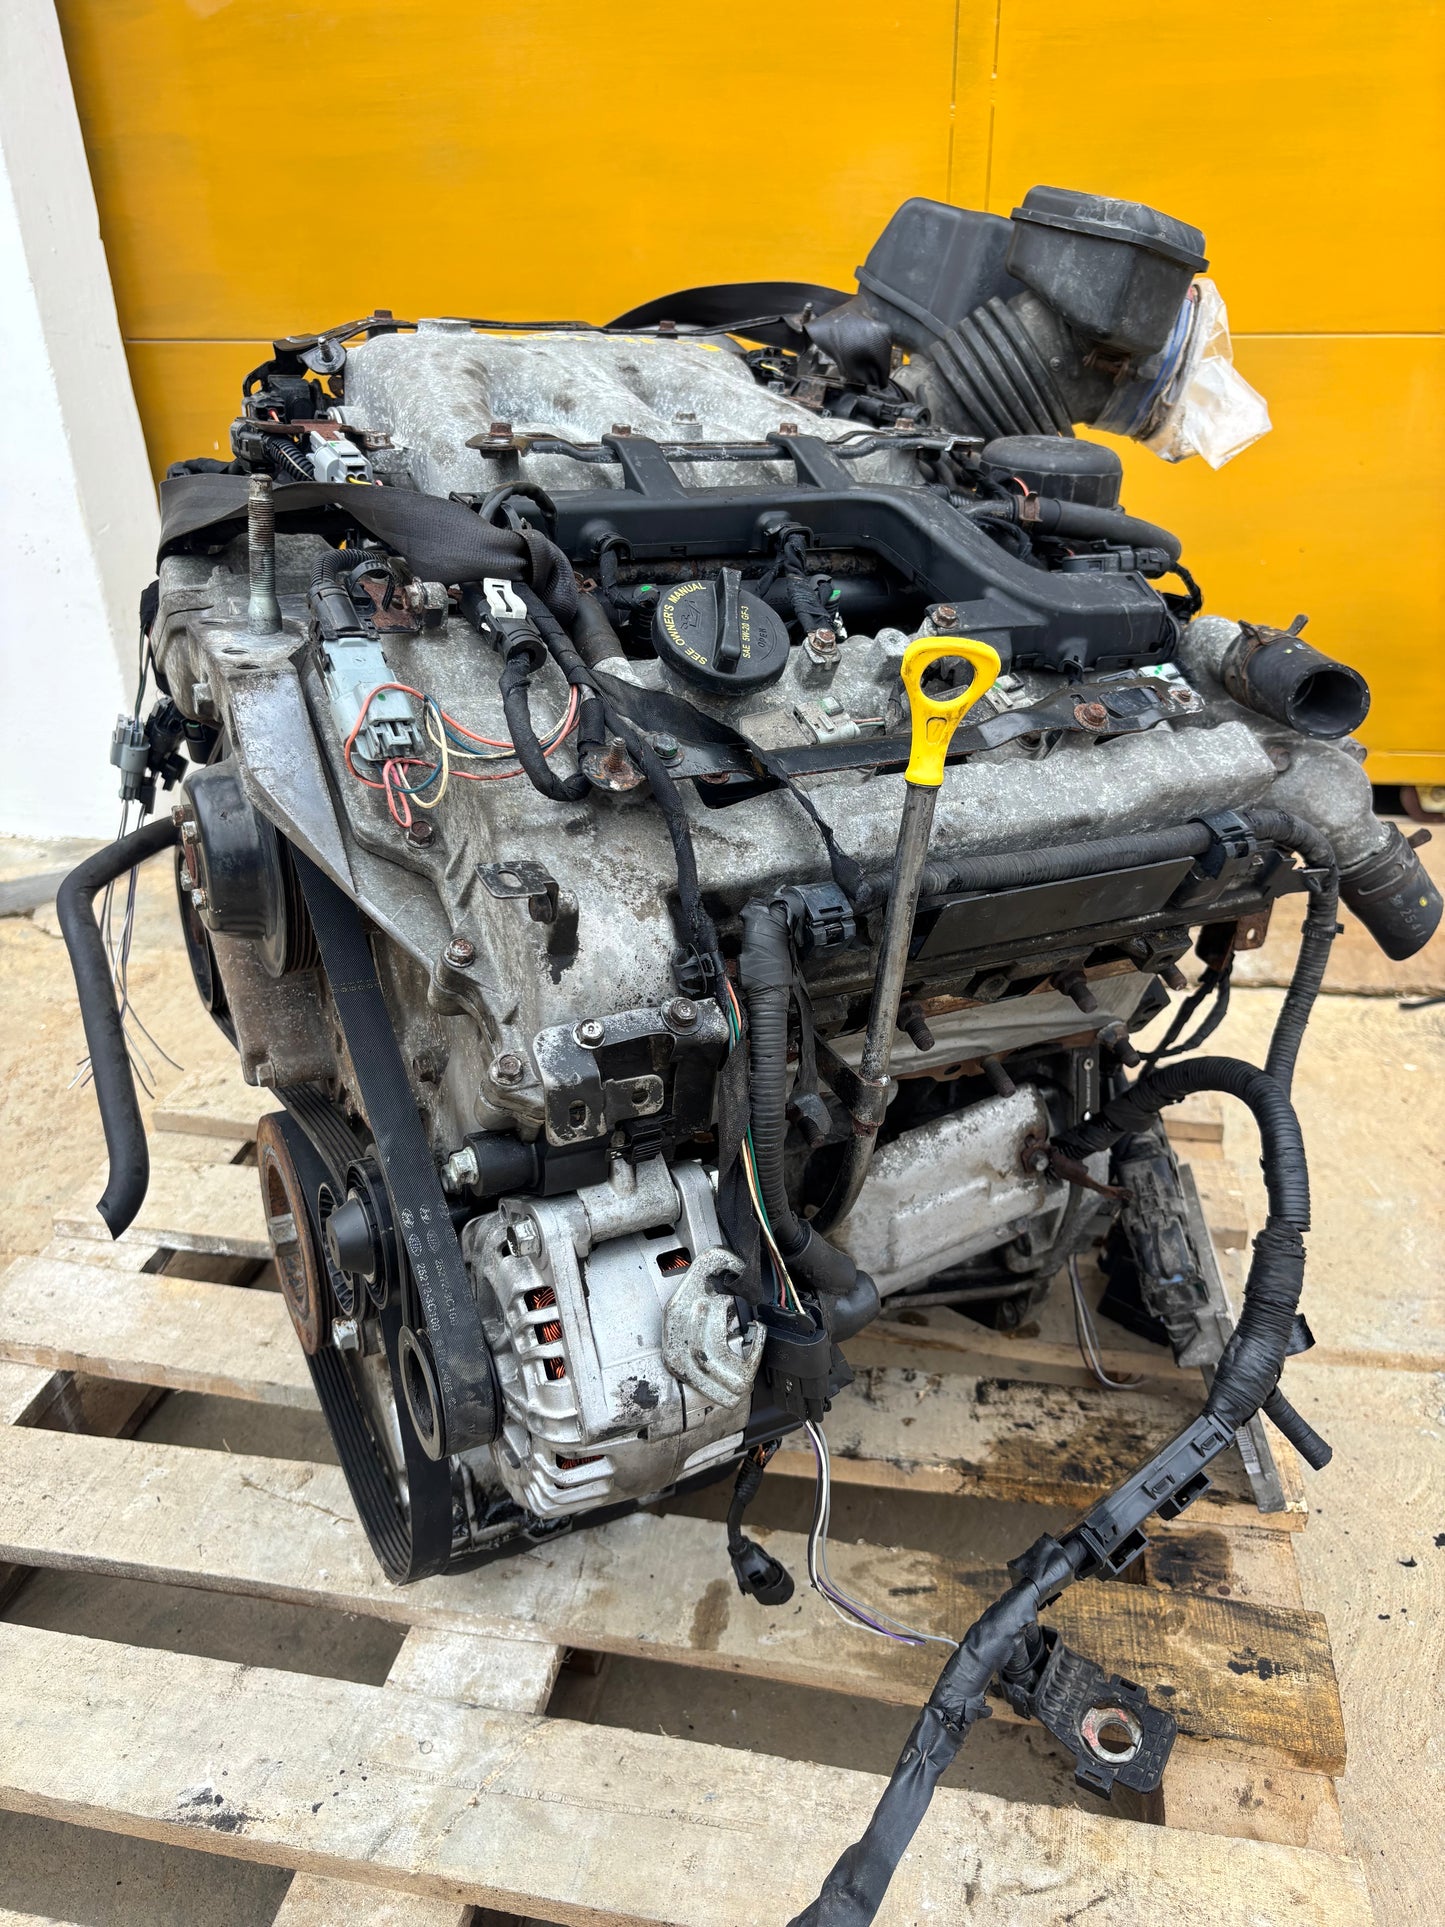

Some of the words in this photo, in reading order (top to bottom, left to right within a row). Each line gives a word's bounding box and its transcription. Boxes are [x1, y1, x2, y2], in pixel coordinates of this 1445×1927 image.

[667, 582, 707, 604] MANUAL
[741, 605, 750, 620] GF-3
[663, 604, 686, 646] OWNER'S
[742, 623, 751, 642] 5W-20
[757, 627, 768, 648] OPEN
[684, 647, 708, 665] SEE
[742, 644, 751, 659] SAE
